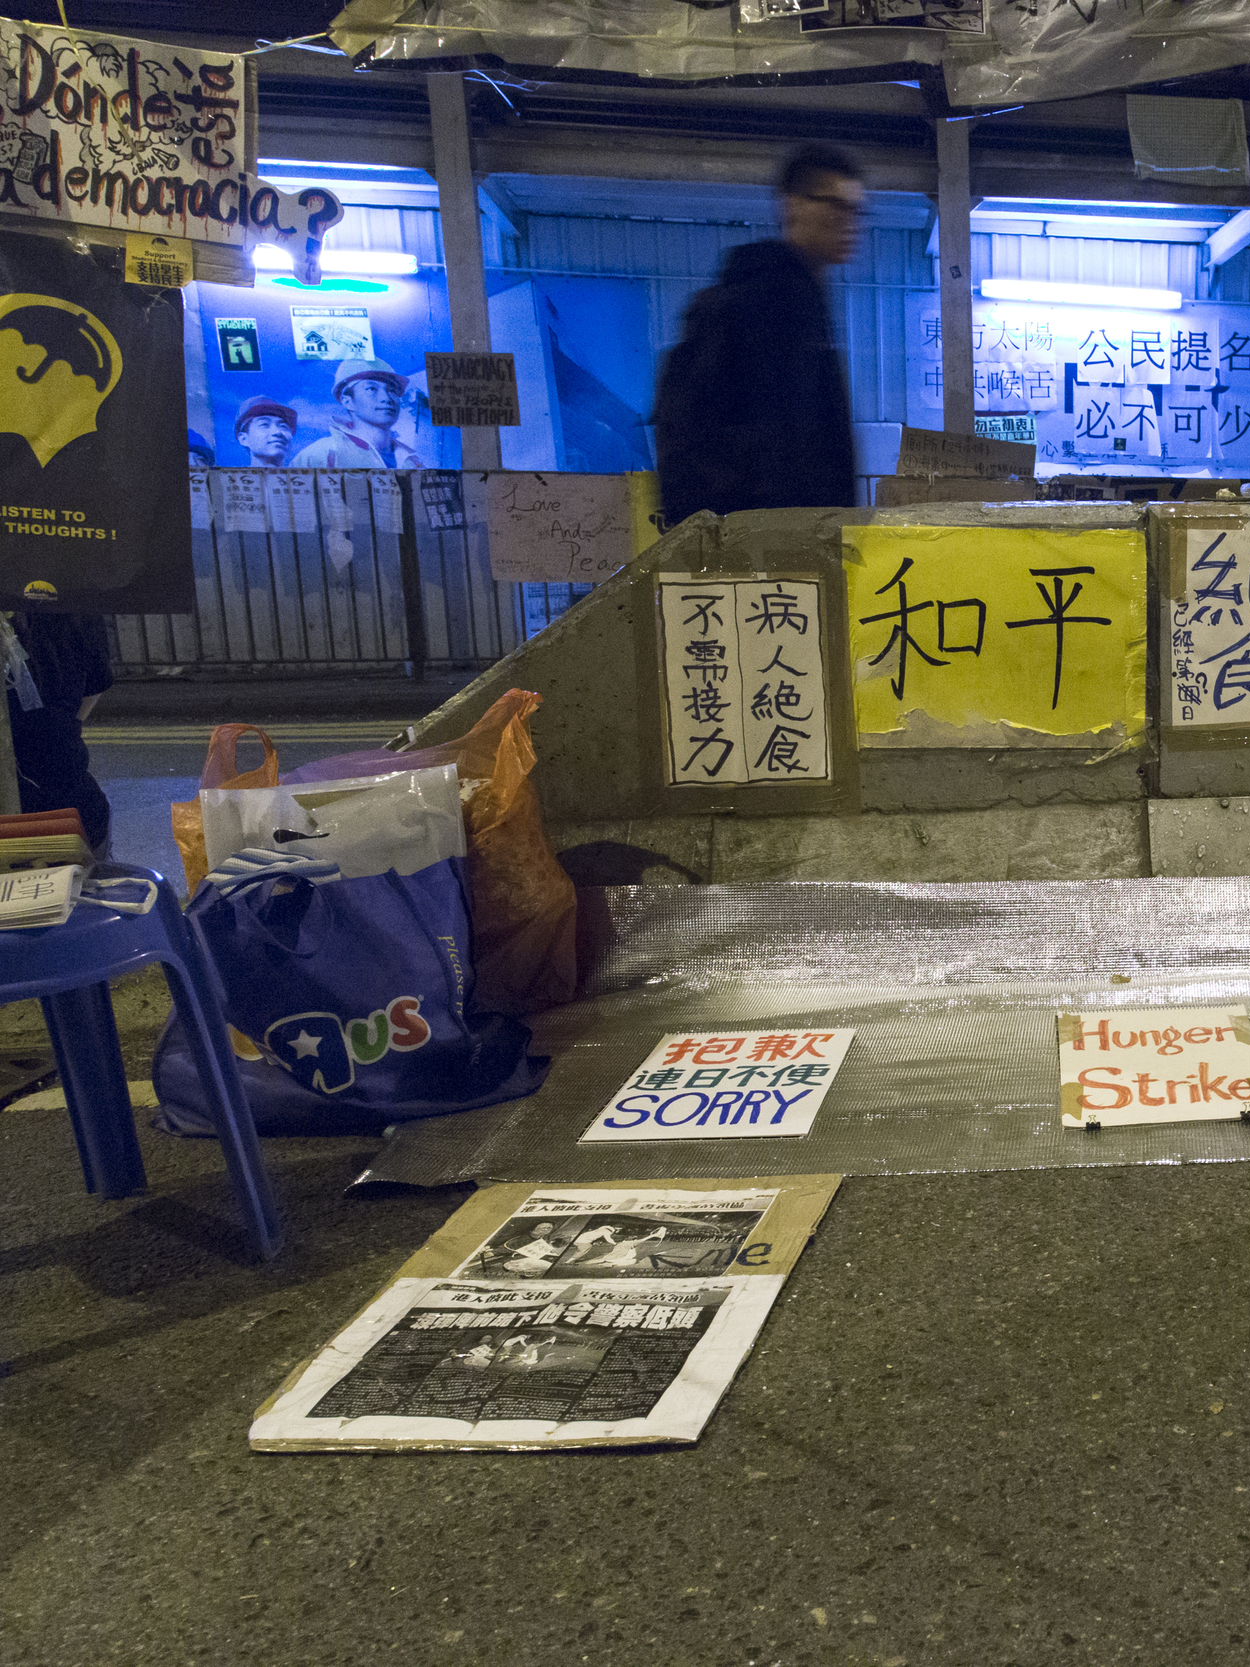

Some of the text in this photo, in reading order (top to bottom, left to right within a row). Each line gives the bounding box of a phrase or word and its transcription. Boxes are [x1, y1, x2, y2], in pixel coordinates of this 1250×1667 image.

[137, 262, 184, 275] 支持學生
[144, 250, 176, 259] Support
[138, 273, 184, 287] 支持民主
[974, 418, 1034, 432] 勿忘初衷!
[502, 484, 561, 513] Love
[0, 505, 86, 523] ISTEN TO
[5, 522, 107, 540] THOUGHTS
[551, 520, 582, 541] And
[558, 540, 625, 577] Peac
[859, 557, 1112, 710] 和平
[680, 594, 735, 777] 不需接力
[437, 935, 464, 996] Please
[662, 1033, 835, 1066] 抱歉
[1072, 1018, 1235, 1056] Hunger
[627, 1063, 831, 1091] 連日不便
[603, 1089, 814, 1129] SORRY
[534, 1302, 704, 1331] 他令警察低頭
